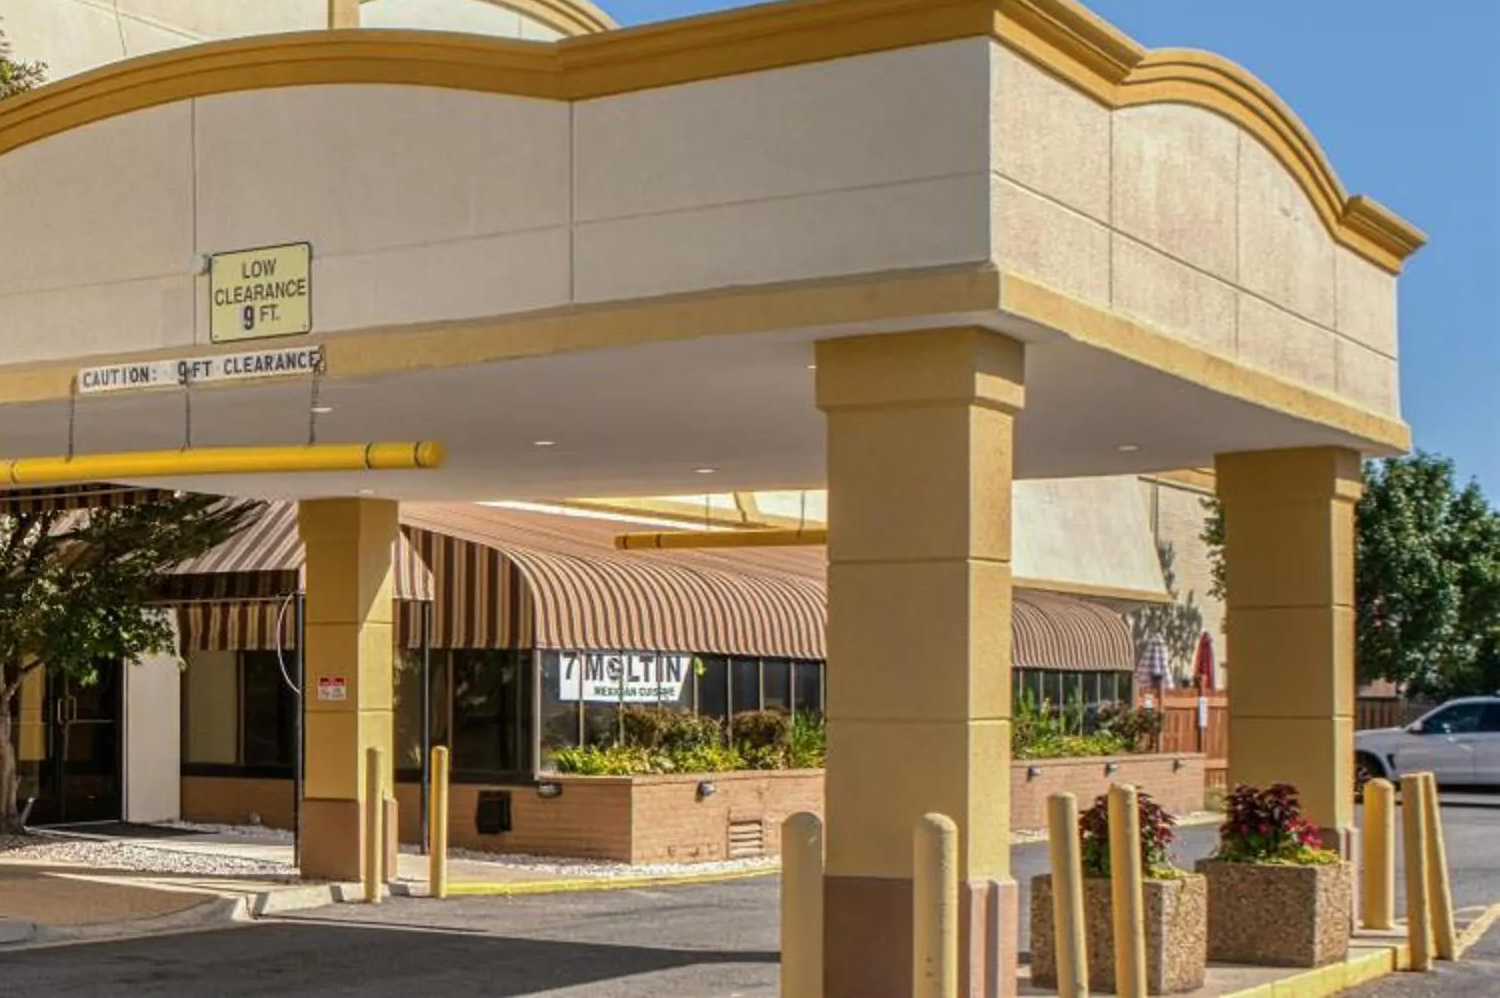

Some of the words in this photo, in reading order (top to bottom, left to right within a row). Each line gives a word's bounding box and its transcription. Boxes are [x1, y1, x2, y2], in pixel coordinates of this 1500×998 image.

[241, 258, 277, 279] LOW
[214, 278, 306, 306] CLEARANCE
[243, 305, 255, 331] 9
[259, 303, 281, 322] FT.
[83, 365, 157, 387] CAUTION:
[178, 360, 187, 385] 9
[192, 360, 213, 378] FT
[224, 351, 319, 374] CLEARANCE
[563, 651, 577, 681] 7
